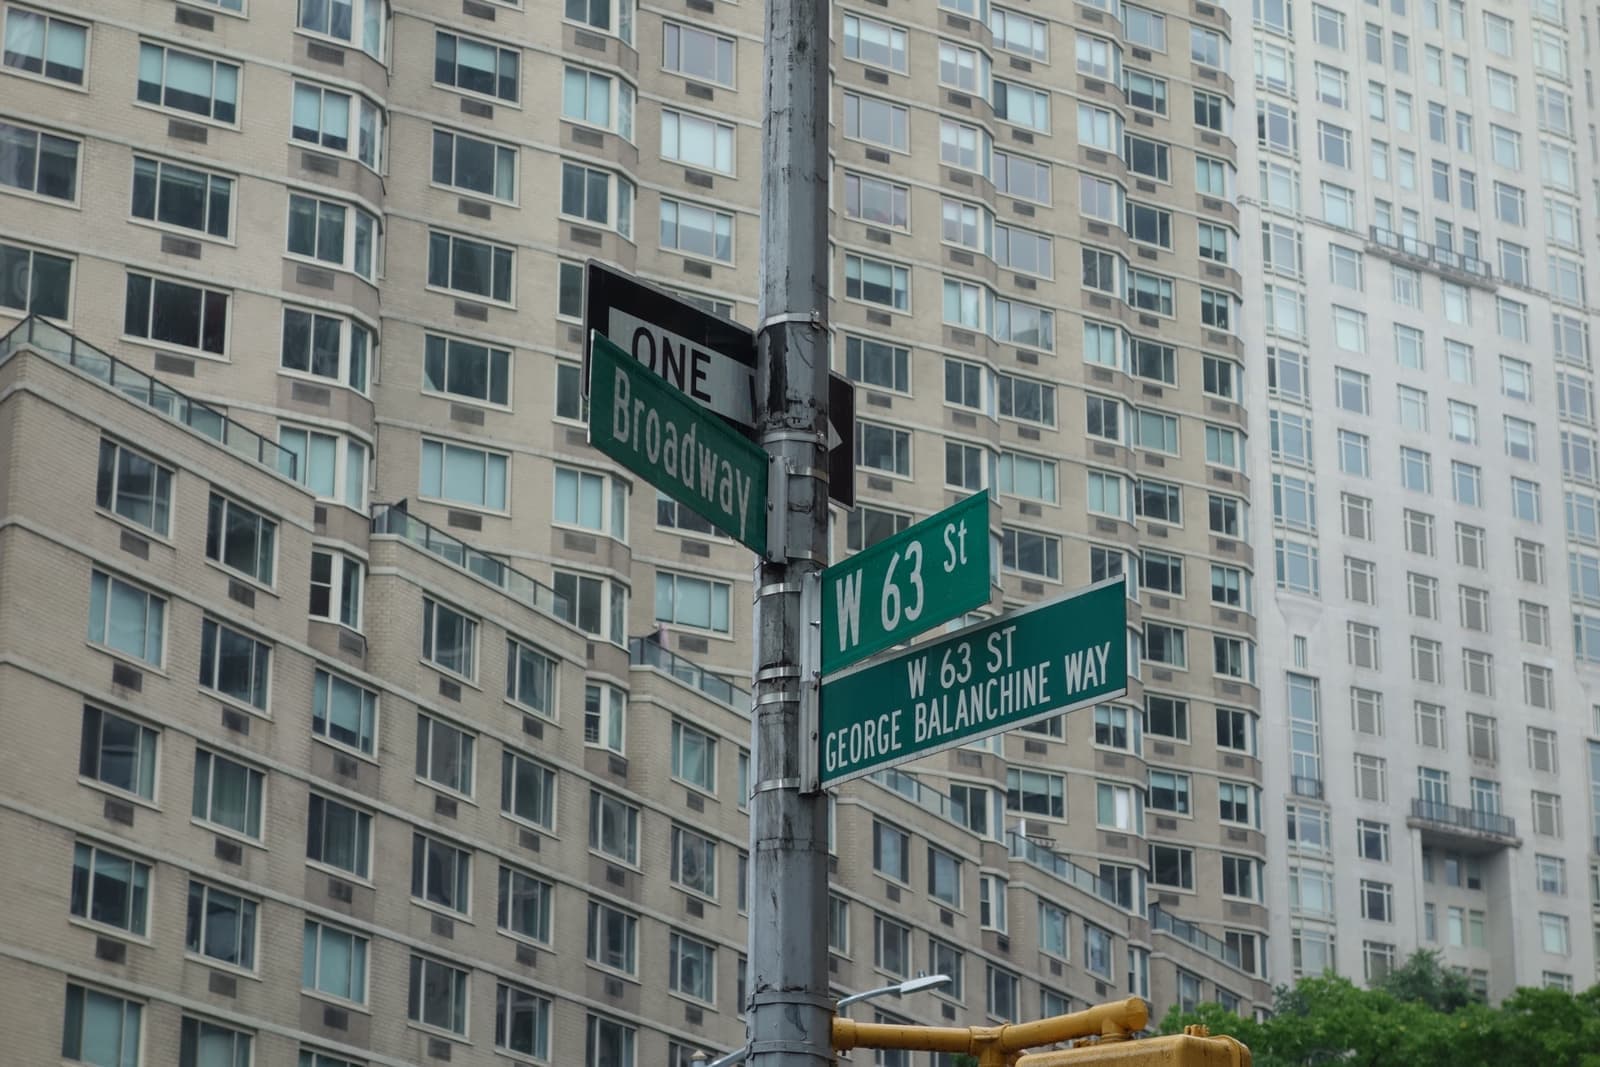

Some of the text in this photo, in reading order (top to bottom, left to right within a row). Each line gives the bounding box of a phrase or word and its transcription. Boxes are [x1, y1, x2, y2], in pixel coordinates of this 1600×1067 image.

[631, 326, 711, 403] ONE
[612, 366, 751, 542] Broadway
[835, 520, 968, 652] W 63 St
[825, 641, 1111, 772] GEORGE BALANCHINE WAY
[907, 625, 1017, 699] W 63 ST
